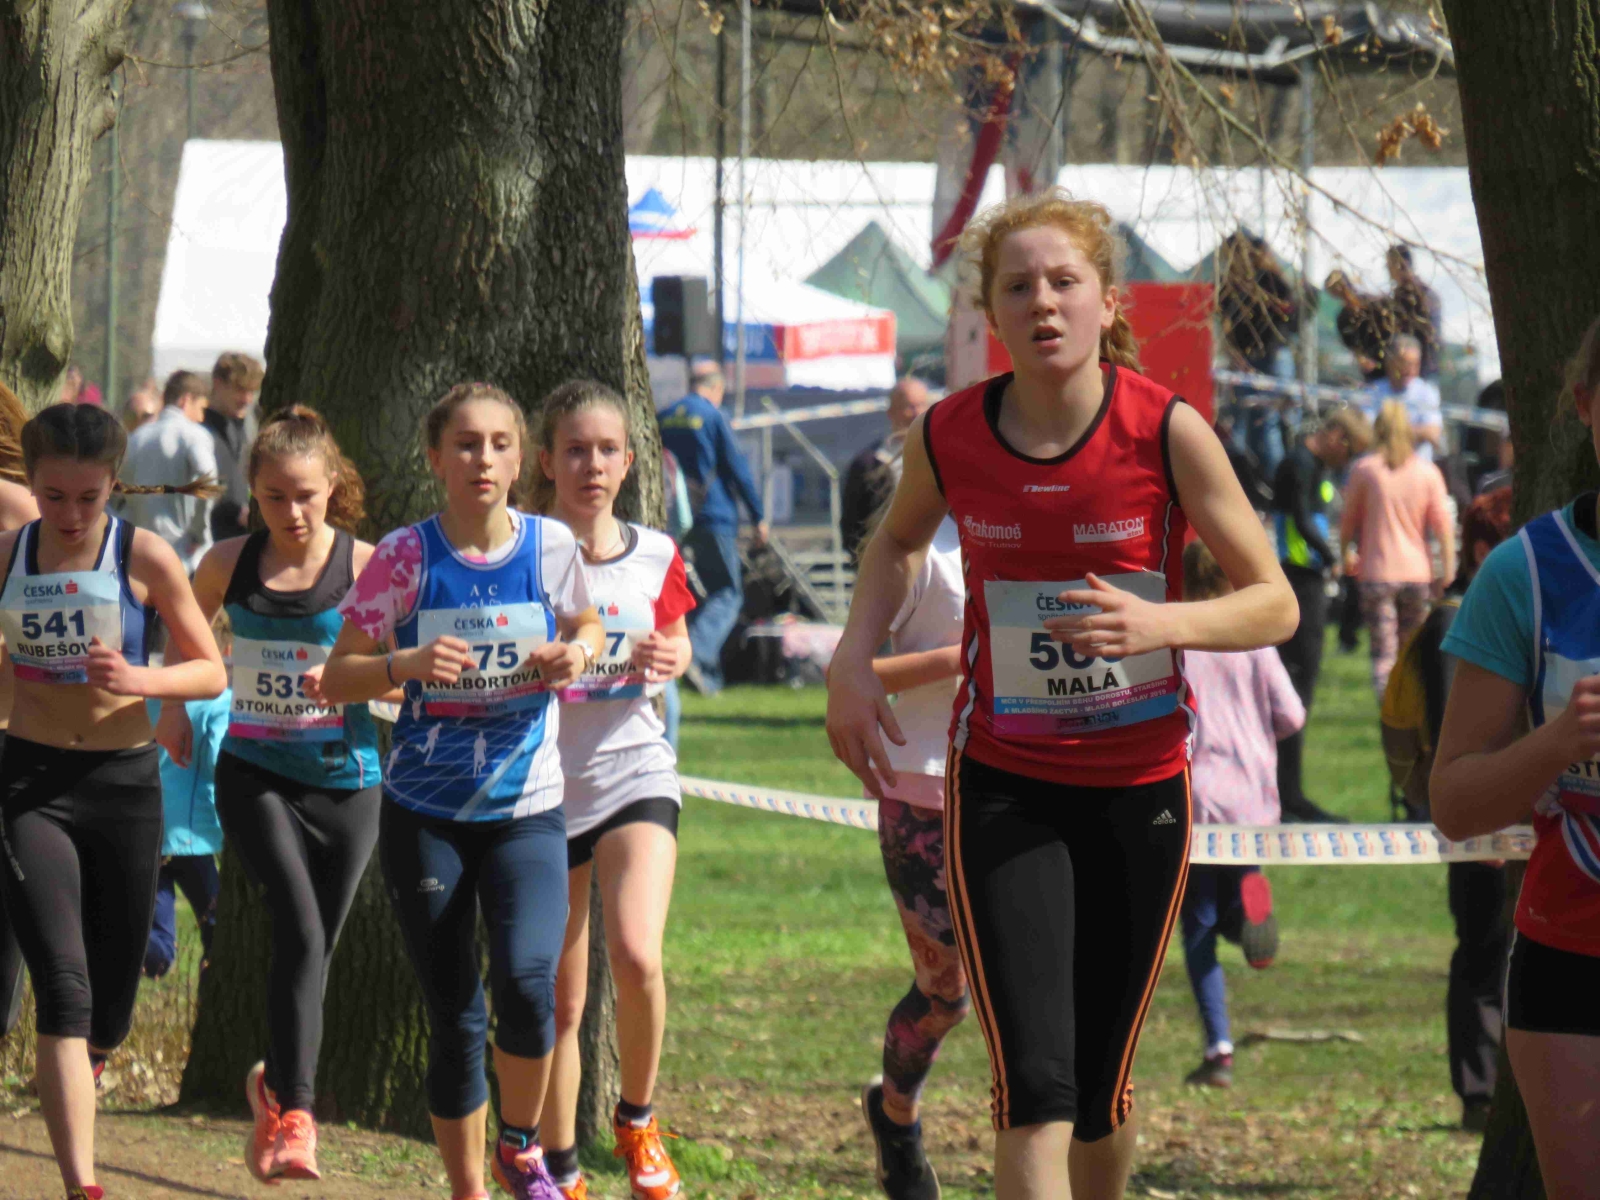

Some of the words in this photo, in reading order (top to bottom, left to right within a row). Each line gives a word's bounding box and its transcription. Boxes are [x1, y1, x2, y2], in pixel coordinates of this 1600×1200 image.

[1073, 516, 1144, 537] MARATON
[23, 582, 63, 598] ČESKÁ
[1036, 592, 1091, 611] ČESK
[22, 609, 85, 640] 541
[454, 615, 494, 631] ČESKÁ
[261, 646, 295, 661] ČESKÁ
[462, 641, 519, 671] 75
[1047, 667, 1120, 696] MALÁ
[1095, 689, 1132, 701] DOROSTU,
